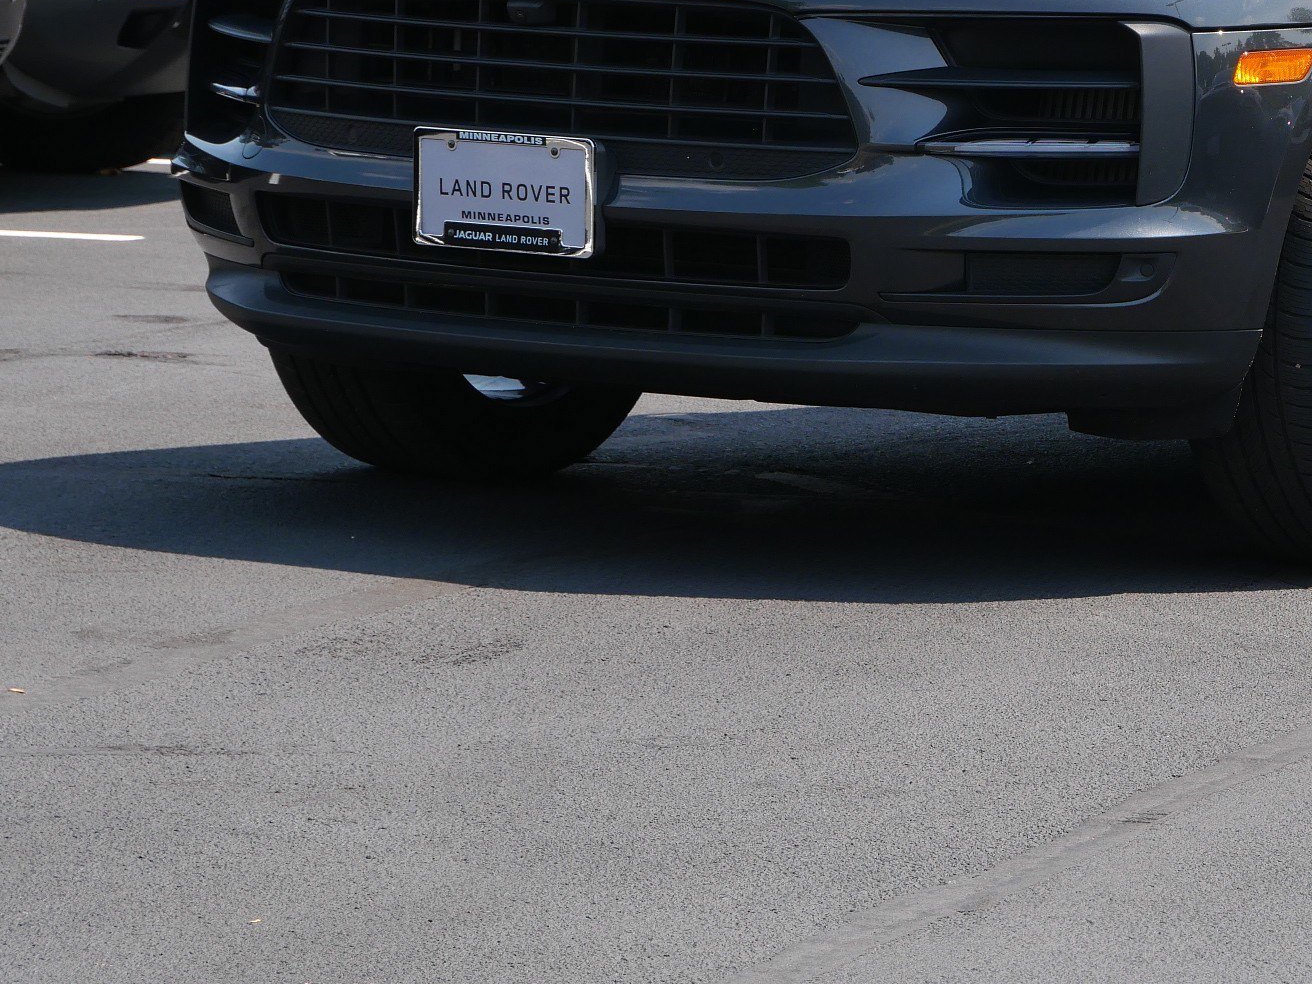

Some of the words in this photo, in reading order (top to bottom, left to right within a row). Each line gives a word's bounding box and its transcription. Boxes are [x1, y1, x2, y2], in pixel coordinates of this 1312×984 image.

[458, 131, 543, 145] MINNEAPOLIS
[439, 177, 492, 199] LAND
[501, 182, 571, 205] ROVER
[461, 210, 550, 225] MINNEAPOLIS
[453, 229, 493, 242] JAGUAR
[495, 233, 518, 244] LAND
[520, 236, 549, 246] ROVER
